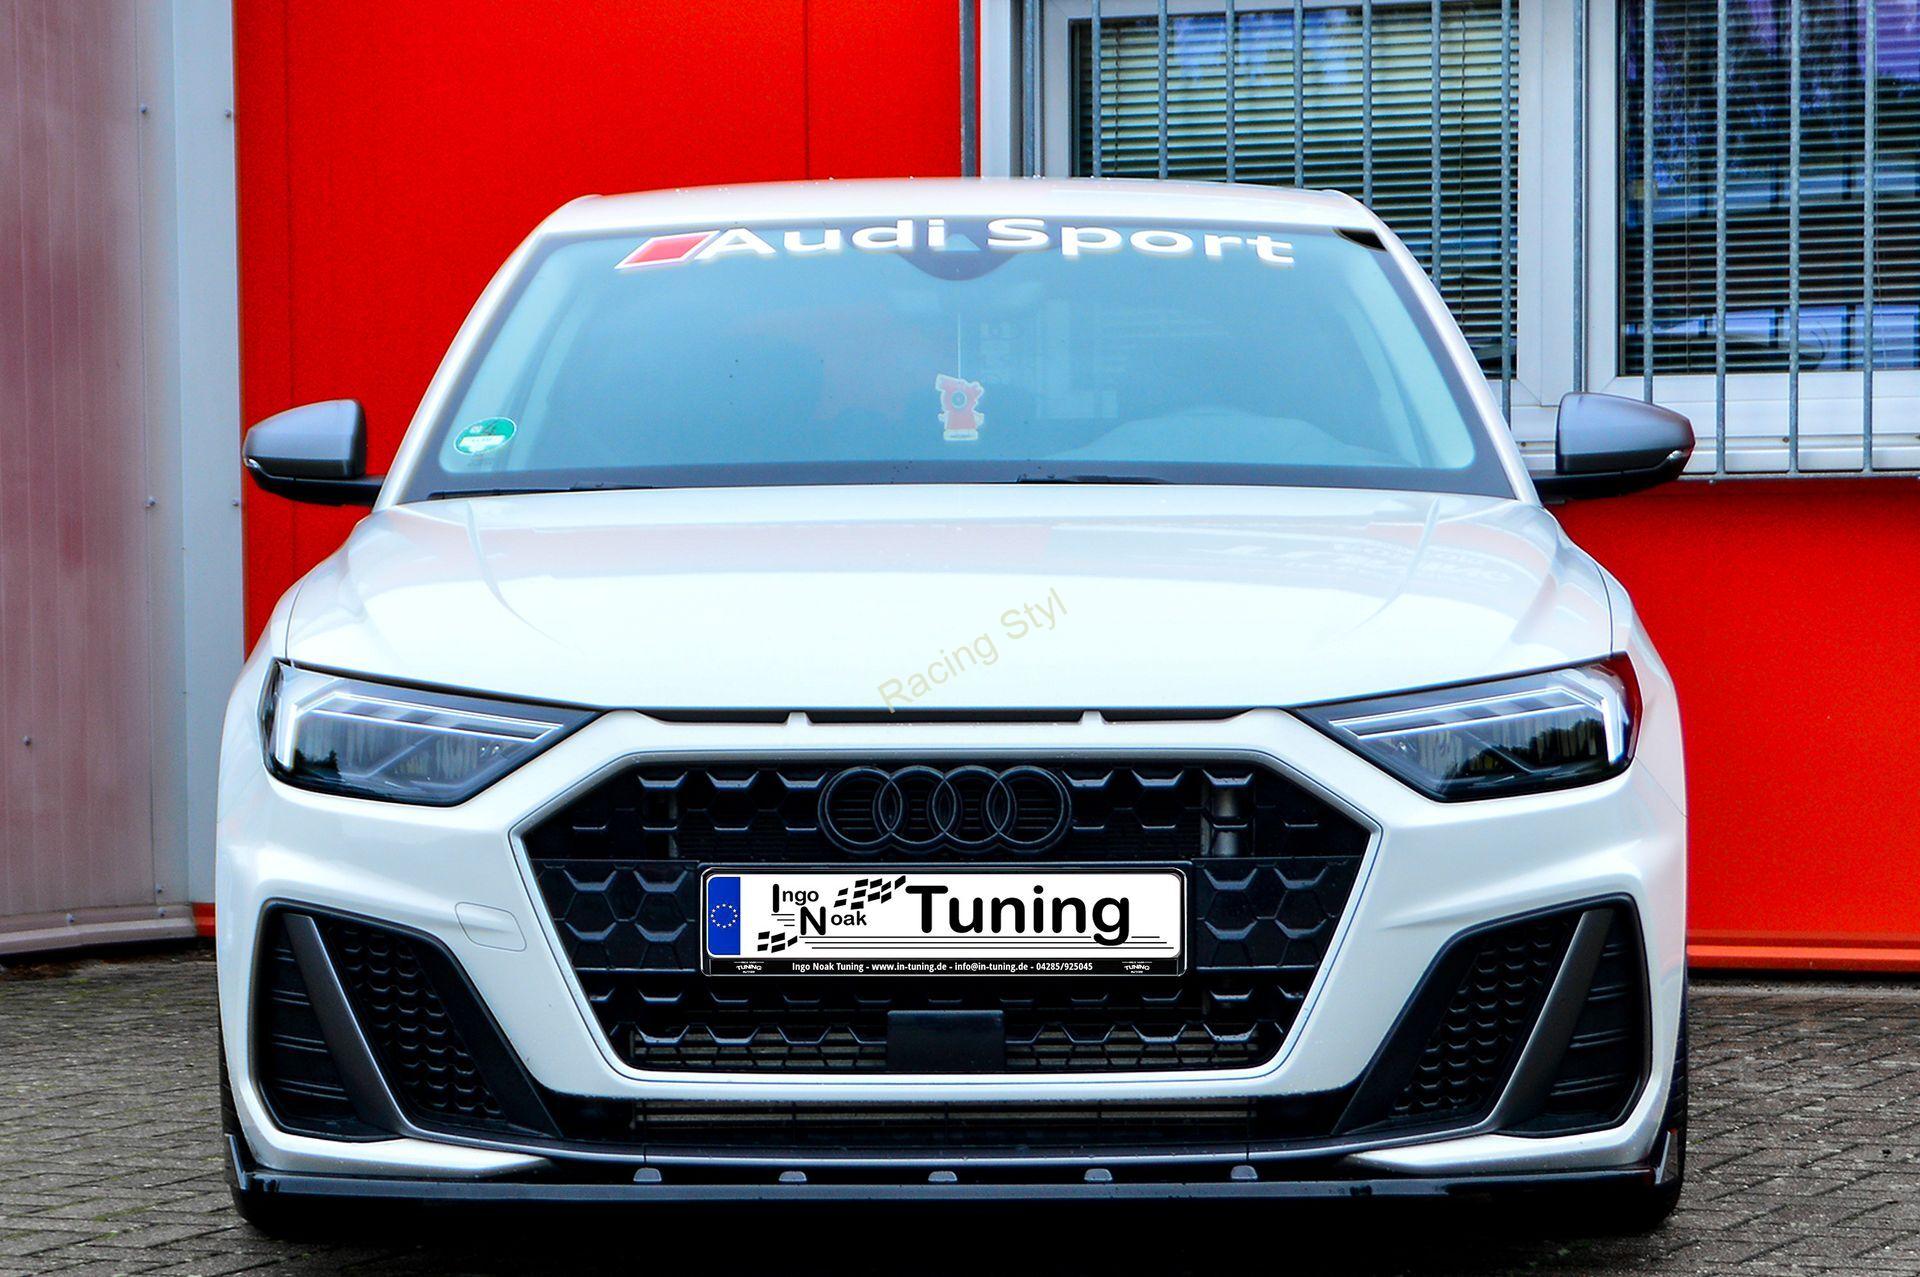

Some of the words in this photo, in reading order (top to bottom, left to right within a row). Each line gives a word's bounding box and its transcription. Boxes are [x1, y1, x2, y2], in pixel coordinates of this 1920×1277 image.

[694, 218, 946, 260] Audi
[986, 217, 1296, 264] Sport
[772, 883, 820, 914] Ingo
[800, 906, 868, 936] Noak
[905, 884, 1130, 946] Tuning
[792, 962, 811, 973] Ingo
[812, 962, 835, 971] Noak
[836, 962, 864, 973] Tuning
[871, 962, 947, 973] www.in-tuning.de
[954, 962, 1028, 973] info@in-tuning.de
[1036, 962, 1093, 971] 04285/925045
